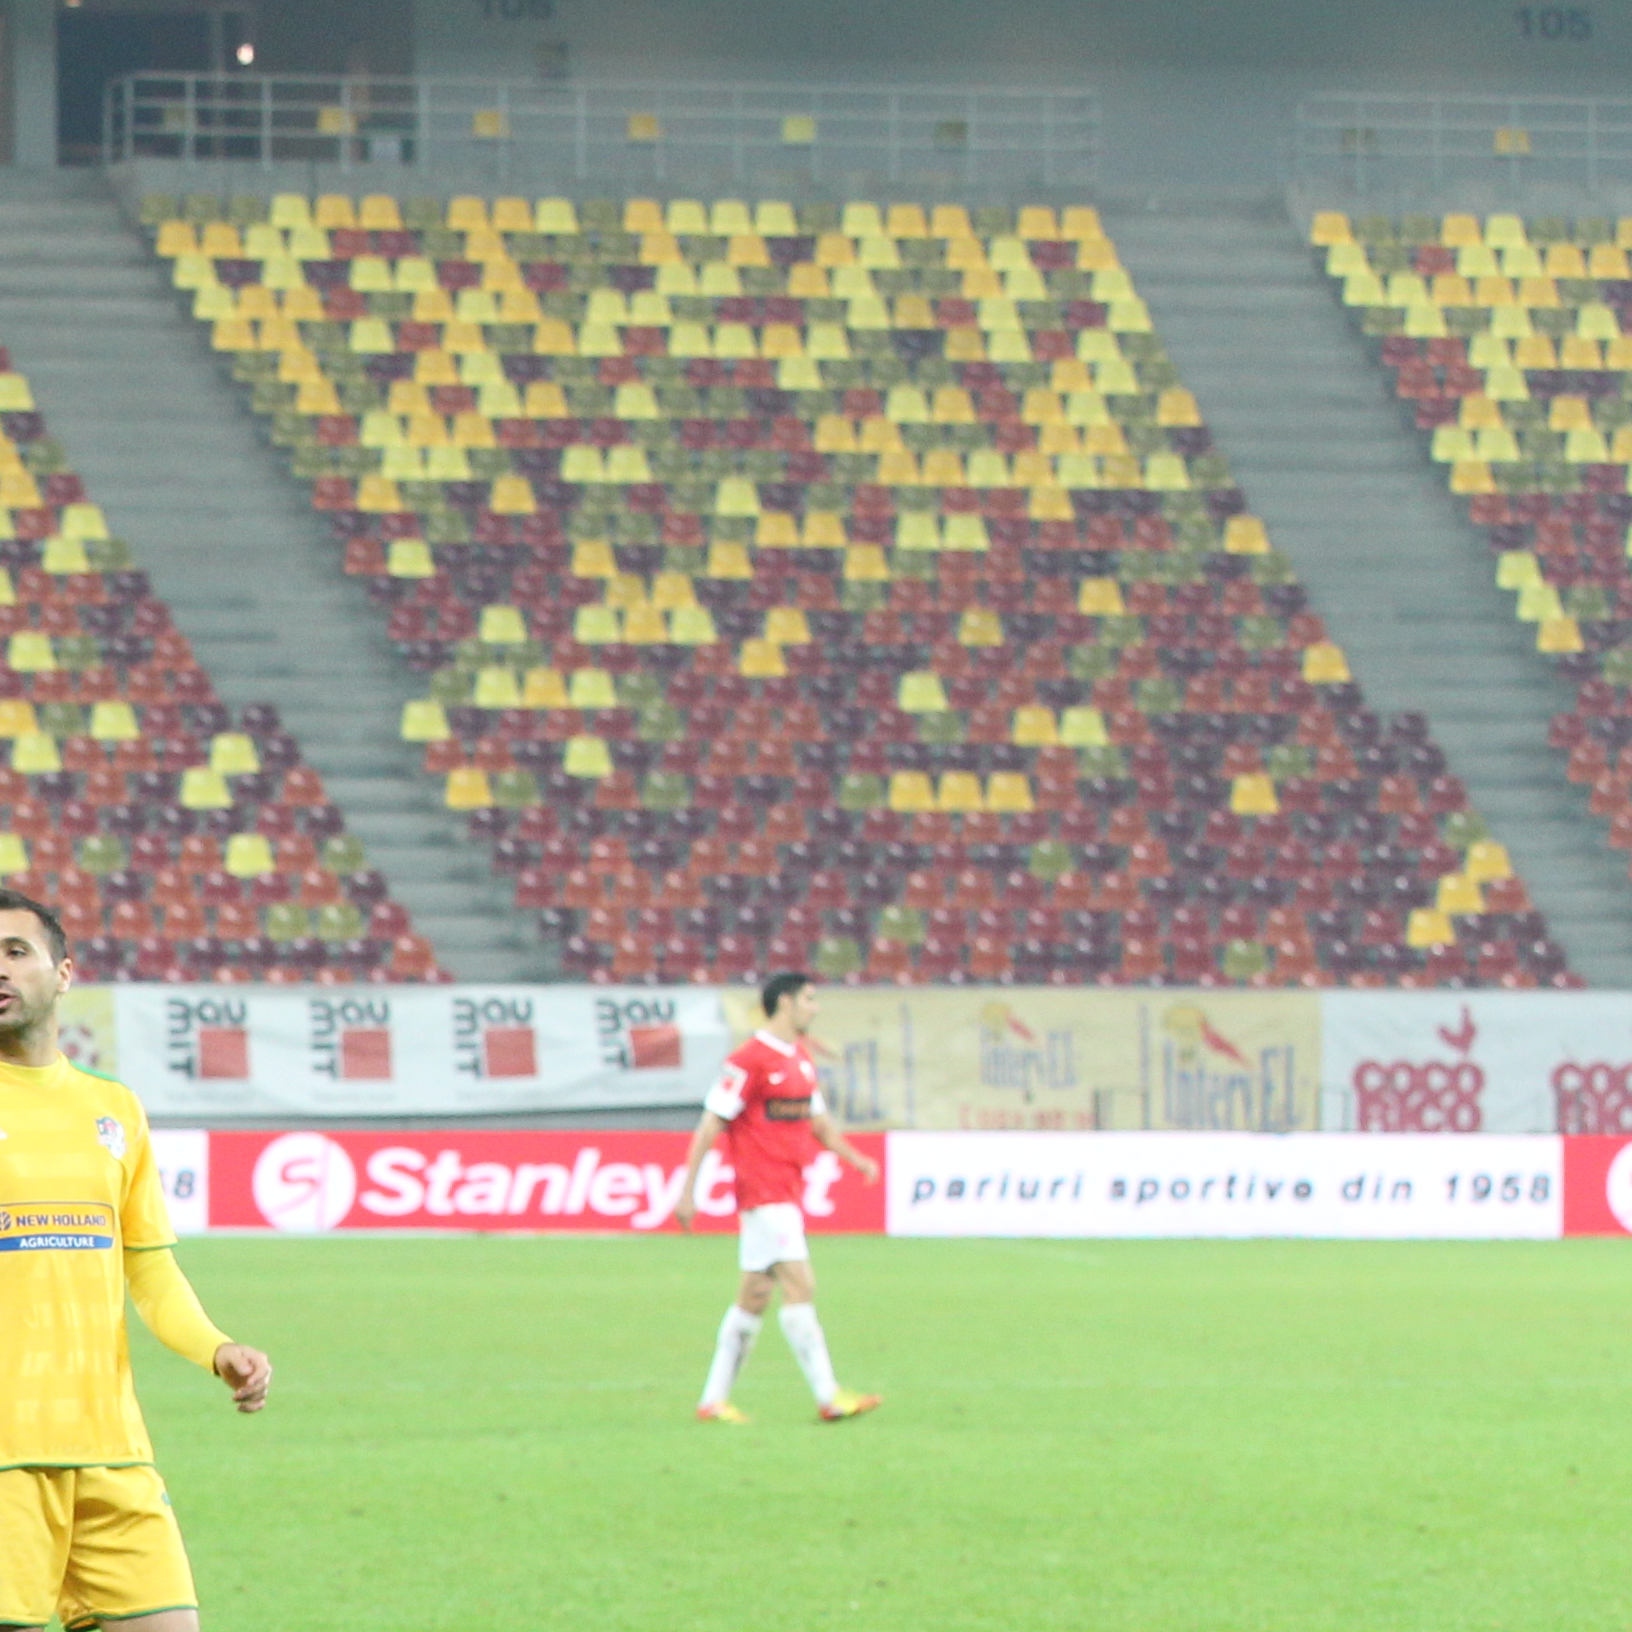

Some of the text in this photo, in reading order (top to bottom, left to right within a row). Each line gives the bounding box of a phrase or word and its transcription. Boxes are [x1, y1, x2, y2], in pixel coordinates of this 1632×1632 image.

[360, 1148, 840, 1228] Stanleybt
[912, 1172, 1552, 1206] pariuri sportive din 1958
[16, 1213, 106, 1227] NEW HOLLAND
[19, 1235, 95, 1249] AGRICULTURE
